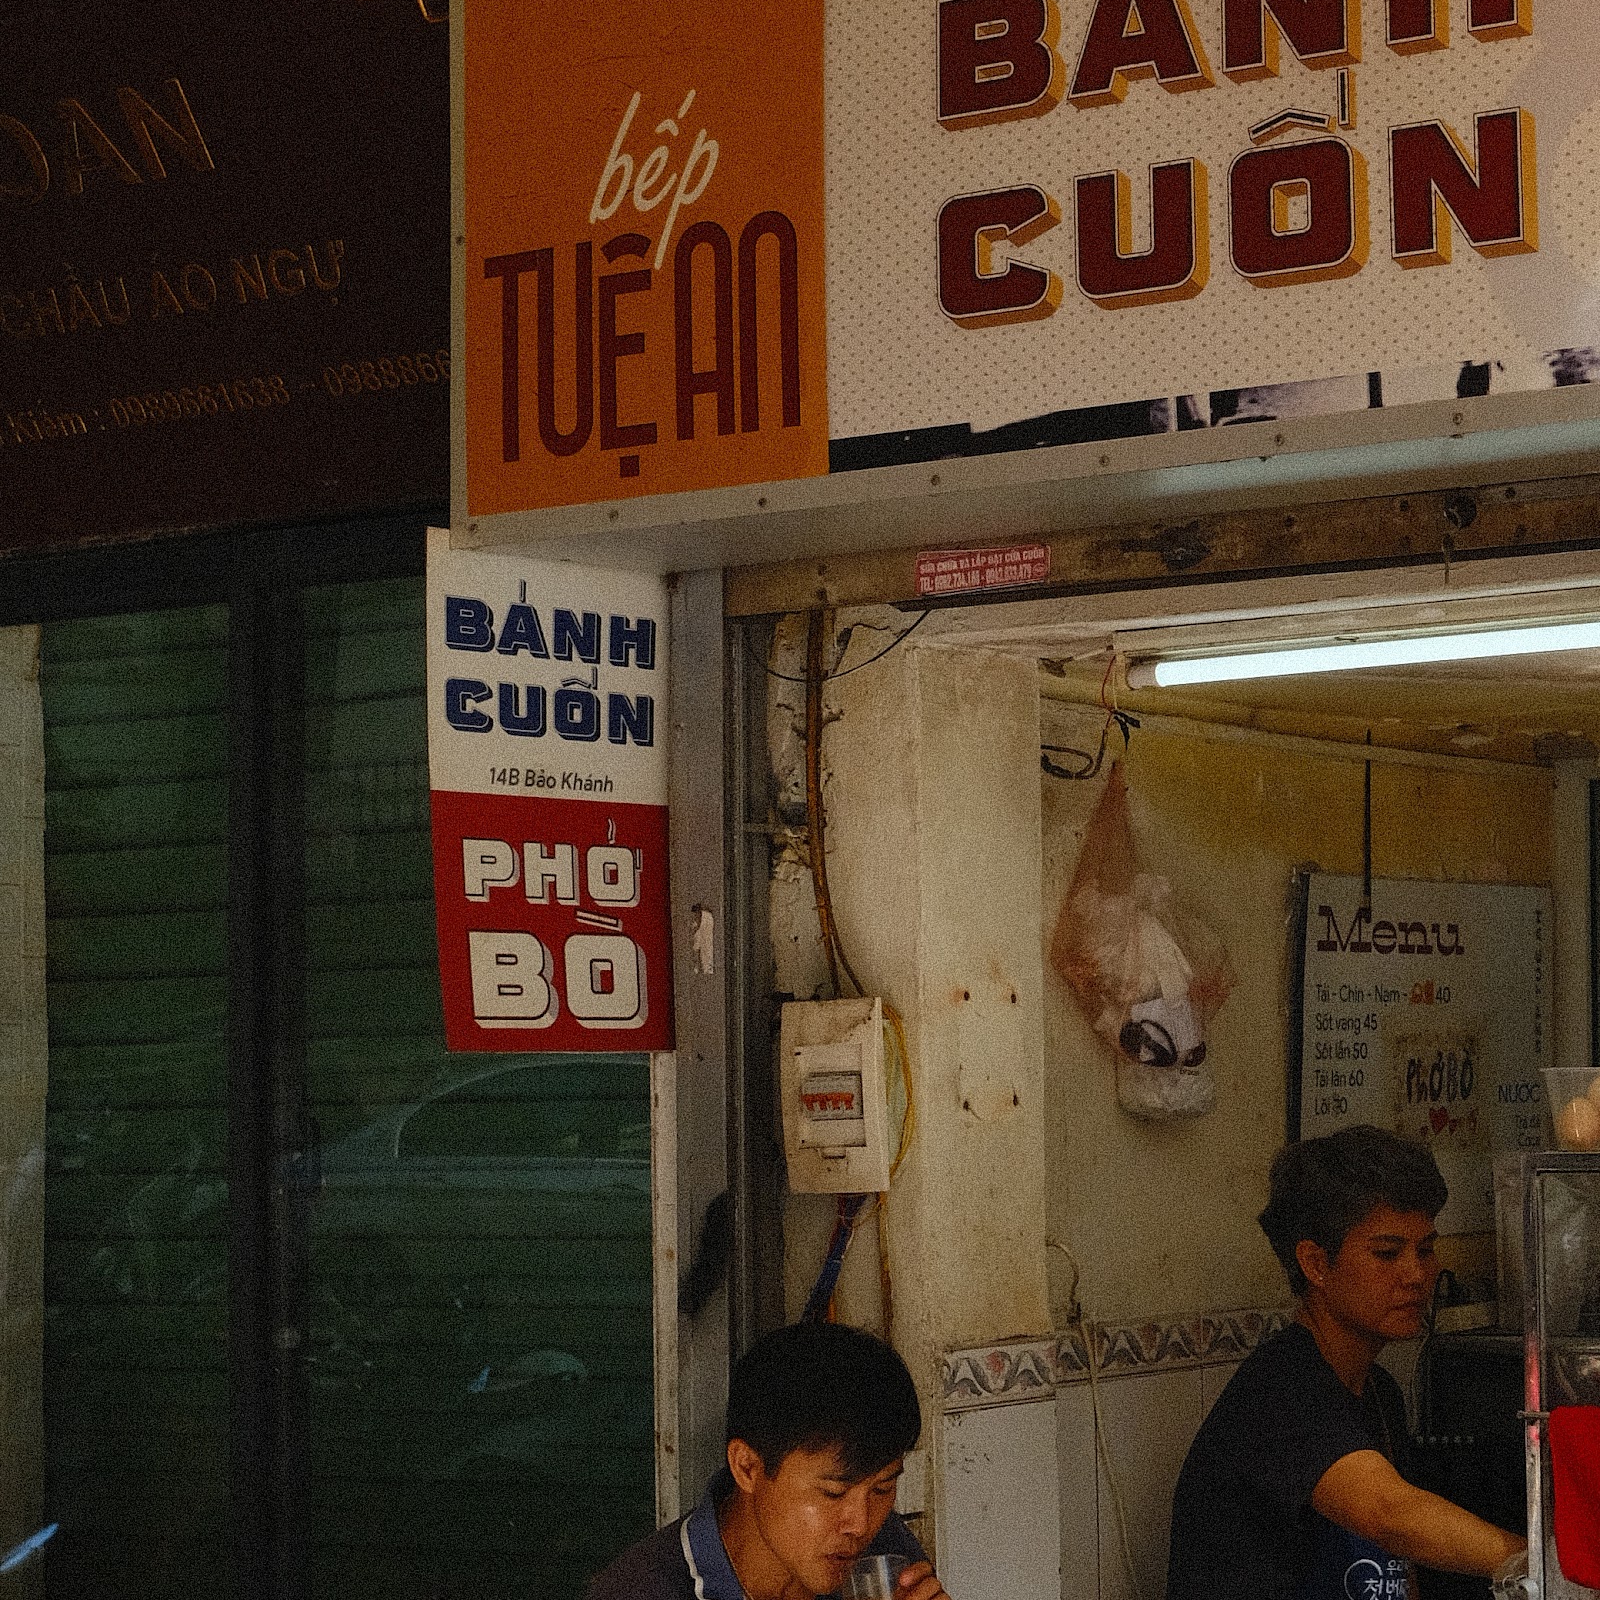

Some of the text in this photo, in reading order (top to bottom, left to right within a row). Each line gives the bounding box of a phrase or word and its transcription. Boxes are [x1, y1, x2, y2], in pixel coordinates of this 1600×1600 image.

[588, 89, 724, 271] bếp
[936, 68, 1539, 330] CUỐN
[484, 233, 658, 478] TUỆ
[445, 580, 656, 669] BÁNH
[445, 665, 654, 747] CUỐN
[490, 767, 614, 793] 14B Bảo Khánh
[462, 818, 643, 907] PHỞ
[469, 910, 648, 1029] BÒ
[1317, 905, 1465, 955] Menu
[1363, 1013, 1378, 1031] 45
